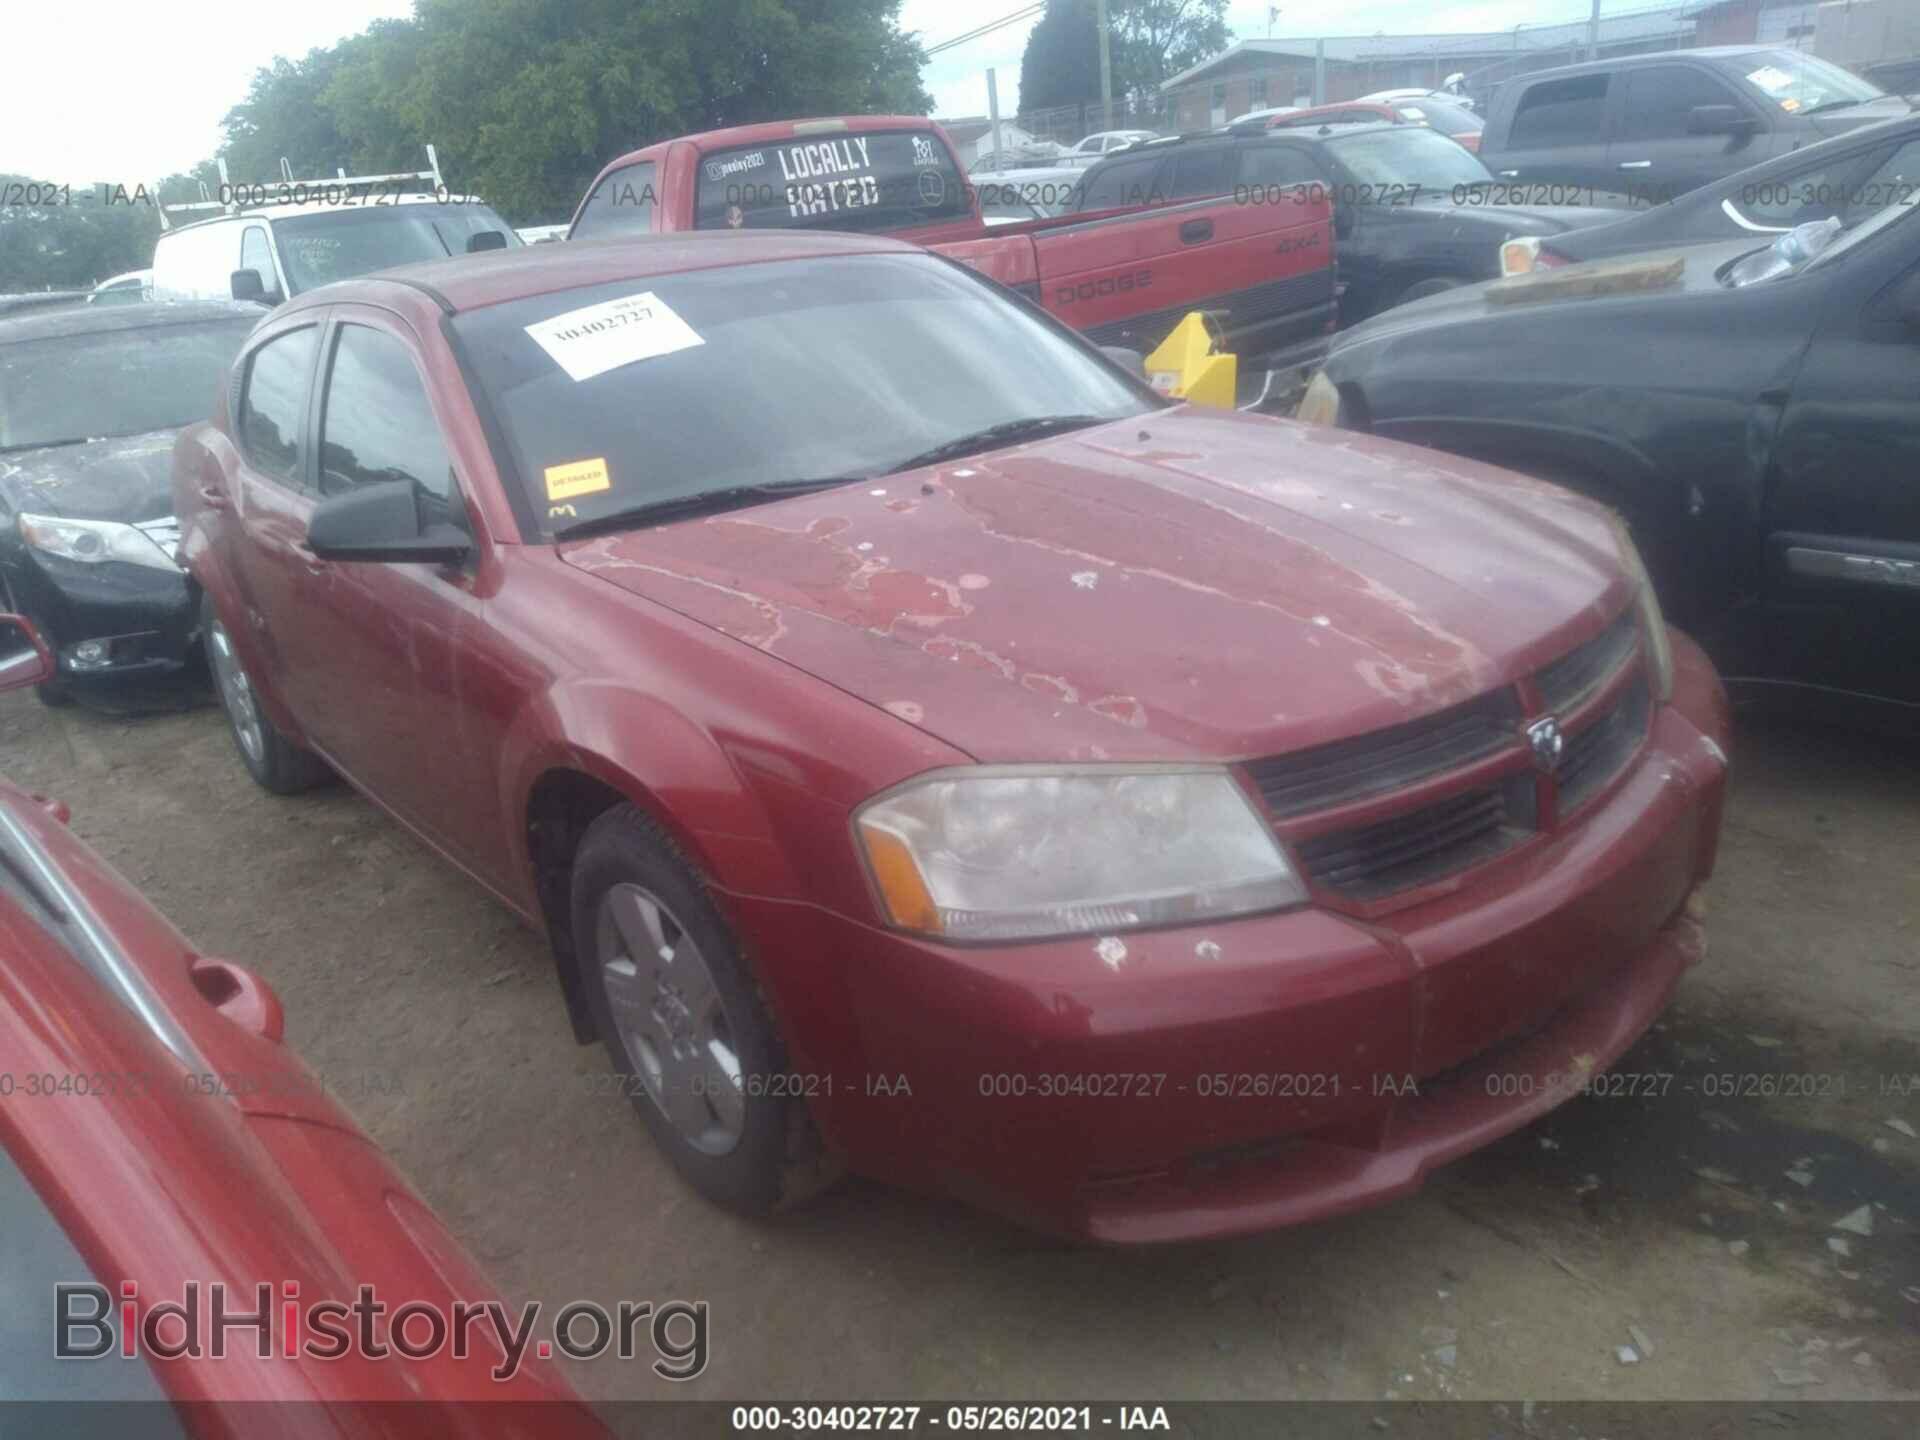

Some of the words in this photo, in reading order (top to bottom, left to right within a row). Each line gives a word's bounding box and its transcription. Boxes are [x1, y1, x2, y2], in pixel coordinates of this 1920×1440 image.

[777, 136, 871, 181] LOCALLY
[1055, 270, 1152, 305] DODGE
[553, 307, 654, 342] 30402727
